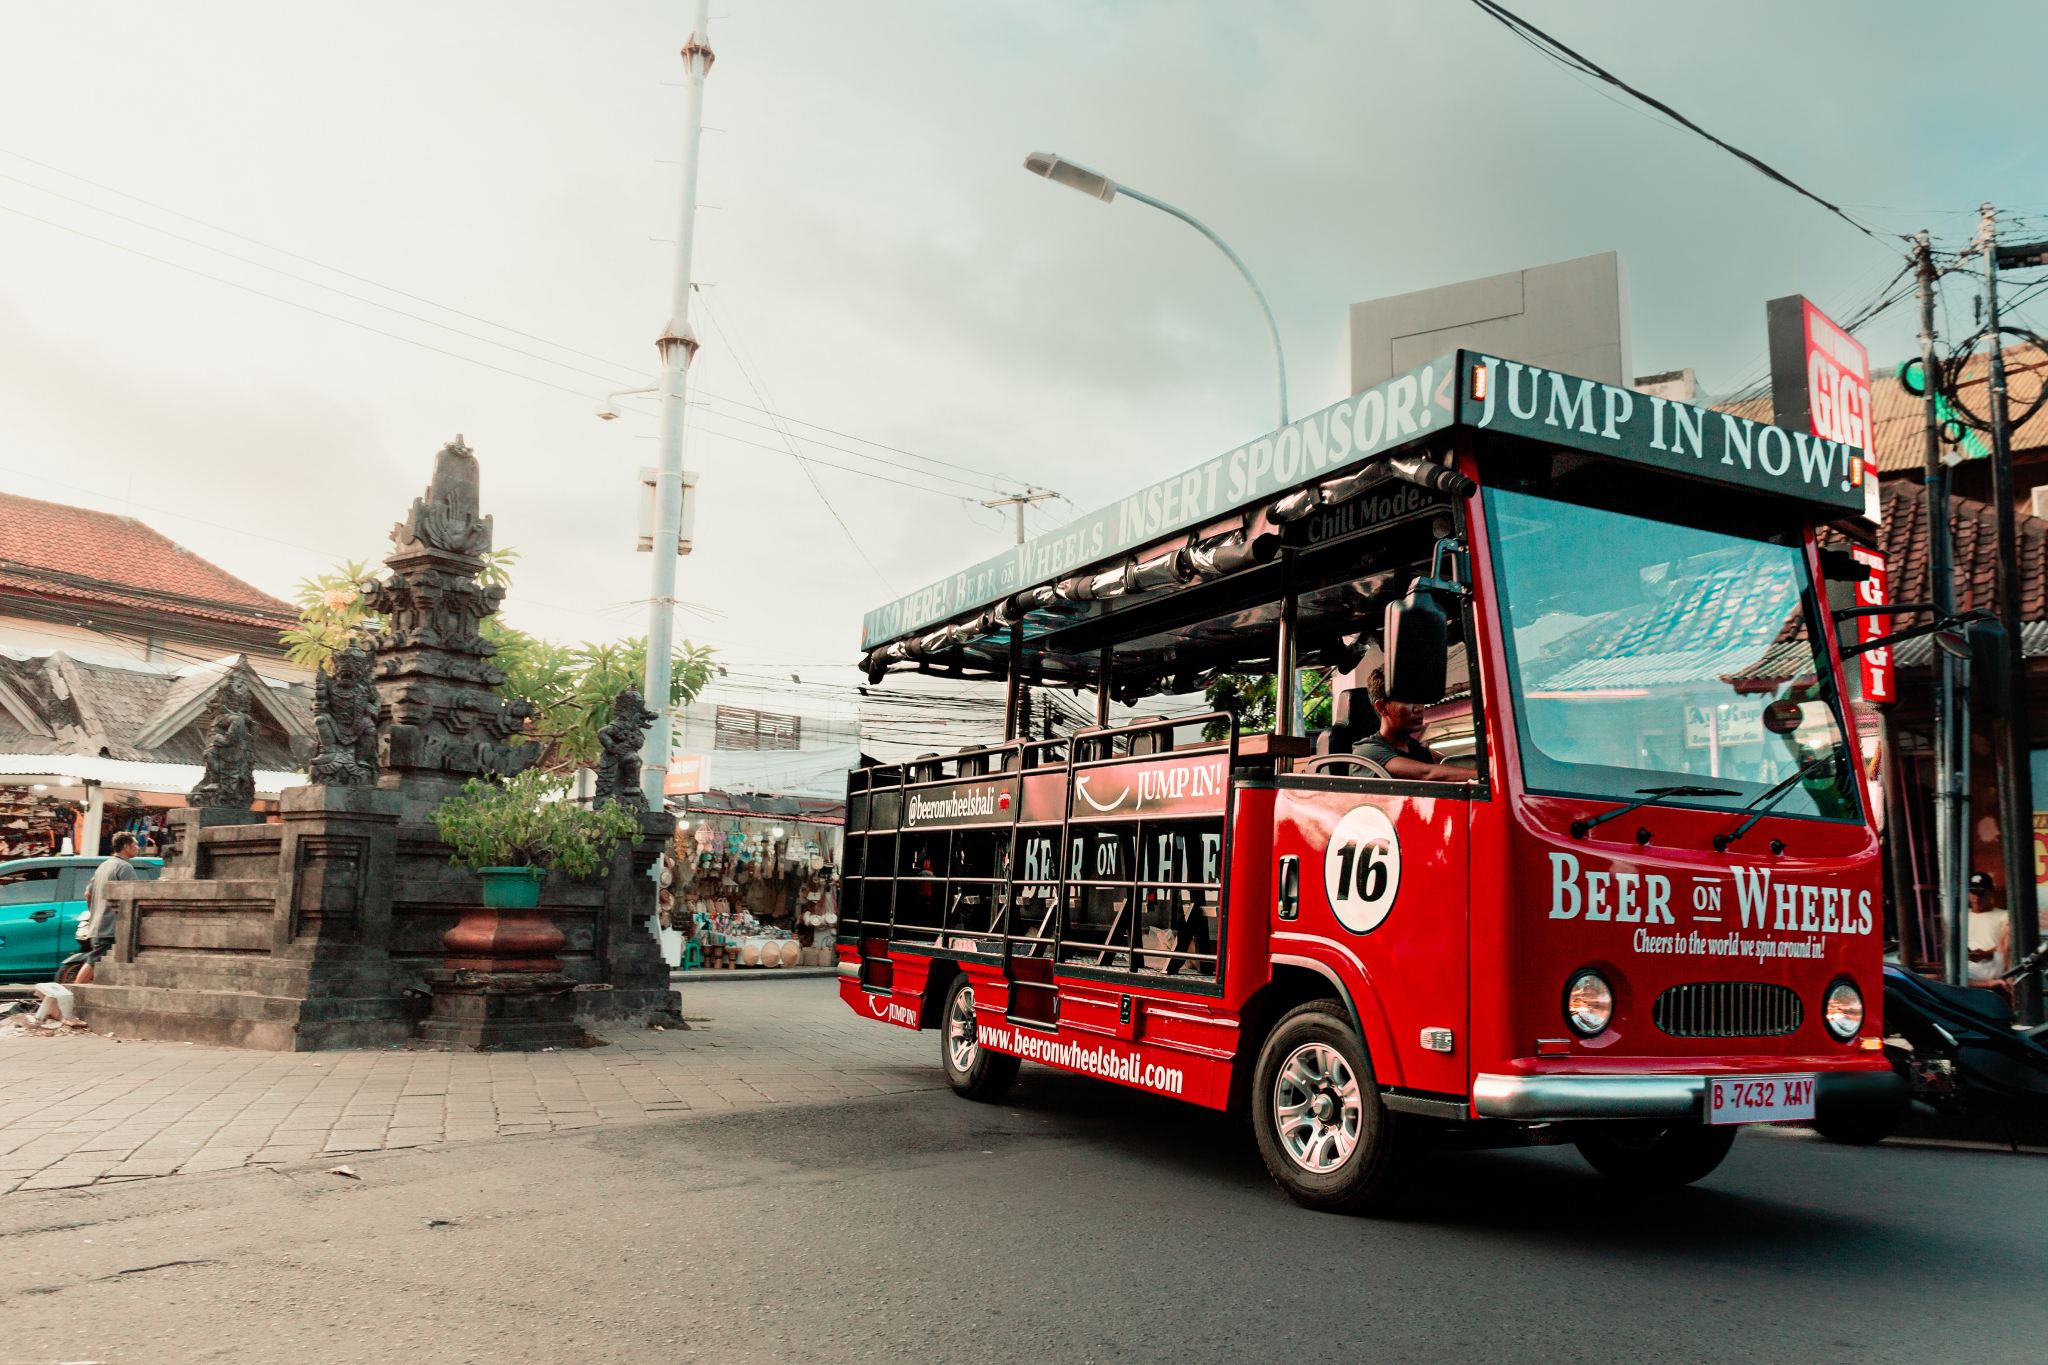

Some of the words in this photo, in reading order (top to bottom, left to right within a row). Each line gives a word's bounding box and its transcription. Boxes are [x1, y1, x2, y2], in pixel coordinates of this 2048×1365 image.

[1478, 355, 1633, 440] JUMP
[1650, 395, 1705, 459] IN
[1721, 413, 1851, 493] NOW!
[1808, 350, 1876, 466] GIGI
[865, 602, 900, 646] ALSO
[901, 578, 949, 632] HERE!
[1018, 521, 1104, 587] WHEELS
[1118, 459, 1223, 546] INSERT
[1226, 366, 1434, 504] SPONSOR!
[1308, 503, 1355, 543] Chill
[908, 786, 995, 826] @beeronwheelsbali
[1135, 764, 1190, 811] JUMP
[1191, 762, 1223, 798] IN!
[1096, 842, 1118, 876] ON
[1336, 837, 1391, 903] 16
[1548, 851, 1675, 925] BEER
[1692, 885, 1722, 911] ON
[1729, 865, 1873, 936] WHEELS
[1633, 927, 1673, 954] Cheers
[1674, 932, 1687, 955] to
[1688, 930, 1706, 956] the
[1707, 931, 1740, 957] world
[1740, 941, 1754, 957] we
[1755, 933, 1777, 965] spin
[1777, 935, 1811, 959] around
[1811, 935, 1826, 960] in!
[887, 1002, 907, 1022] JUMP
[906, 1008, 917, 1027] IN!
[977, 1024, 1184, 1094] www.beeronwheelsbali.com
[1713, 1084, 1724, 1110] B
[1733, 1082, 1775, 1109] 7432
[1783, 1080, 1813, 1106] XAY
